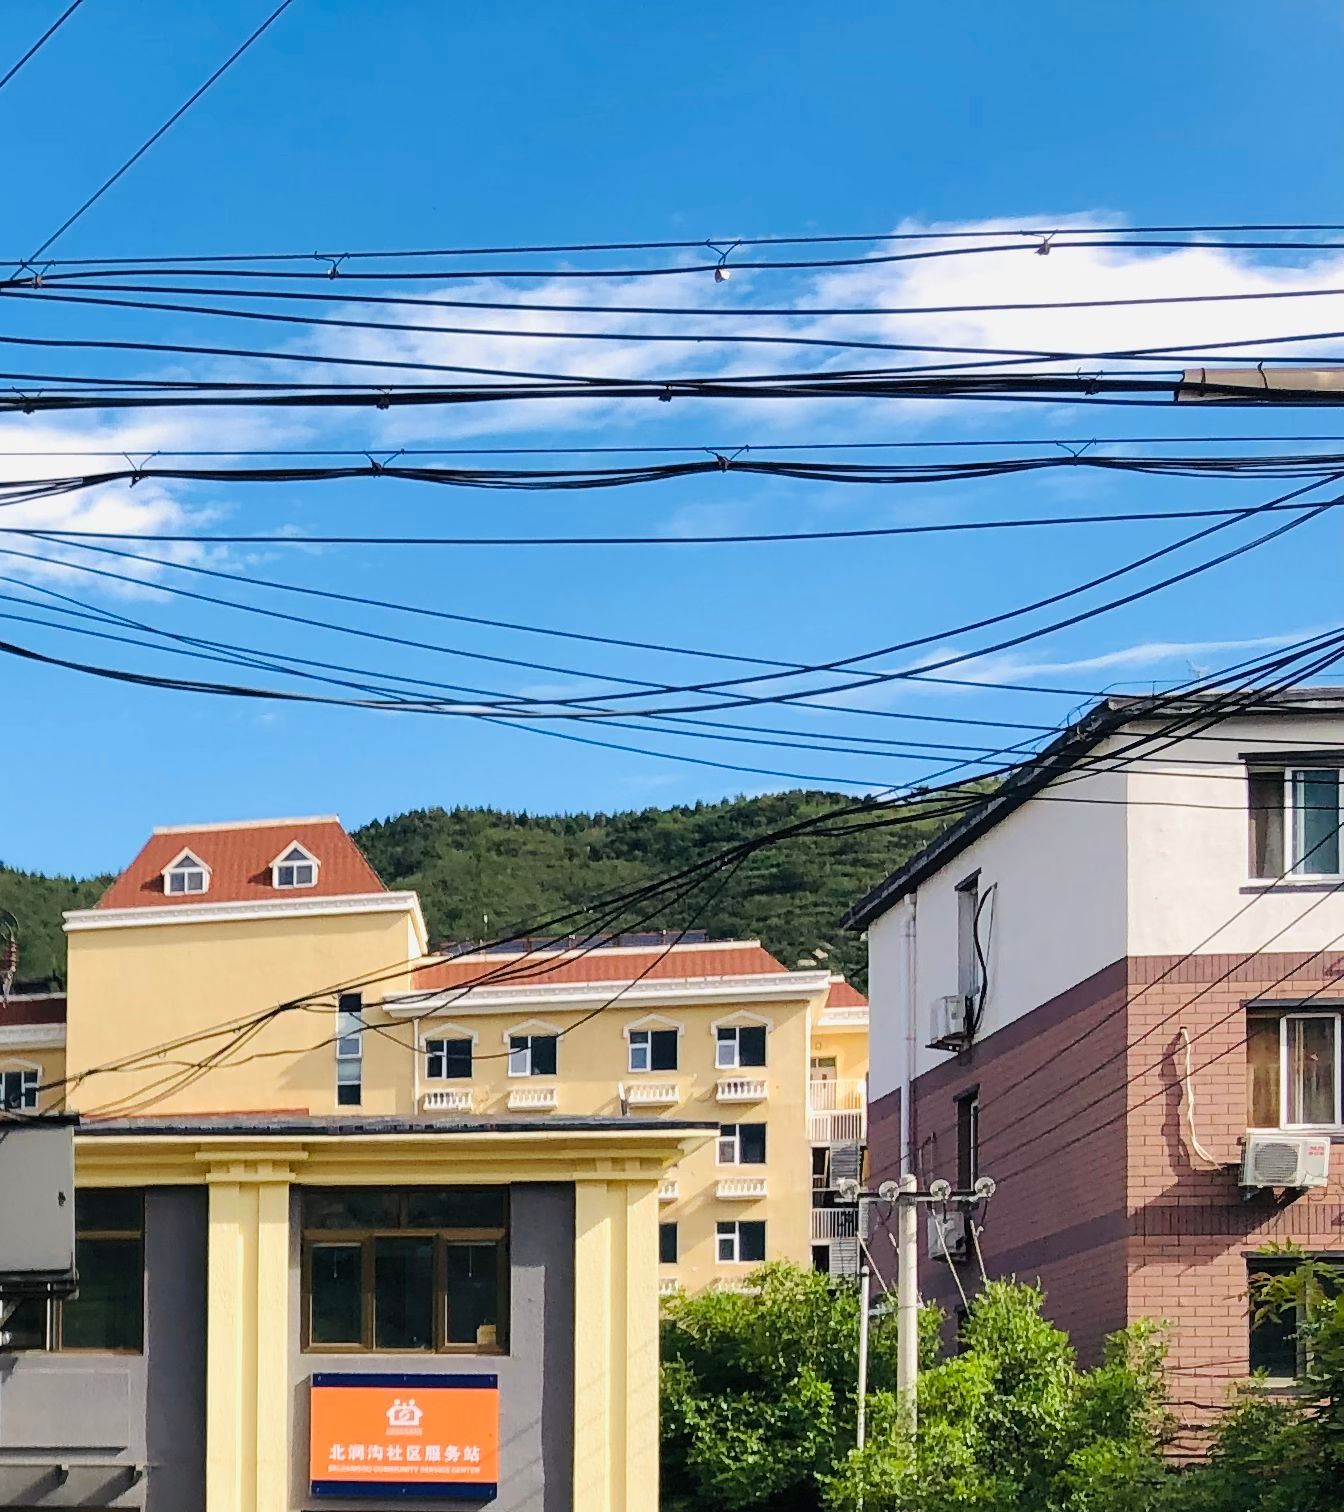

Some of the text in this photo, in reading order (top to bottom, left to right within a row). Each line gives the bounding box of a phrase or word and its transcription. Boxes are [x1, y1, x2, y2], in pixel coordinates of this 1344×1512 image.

[329, 1443, 481, 1463] 北涧沟社区服务站
